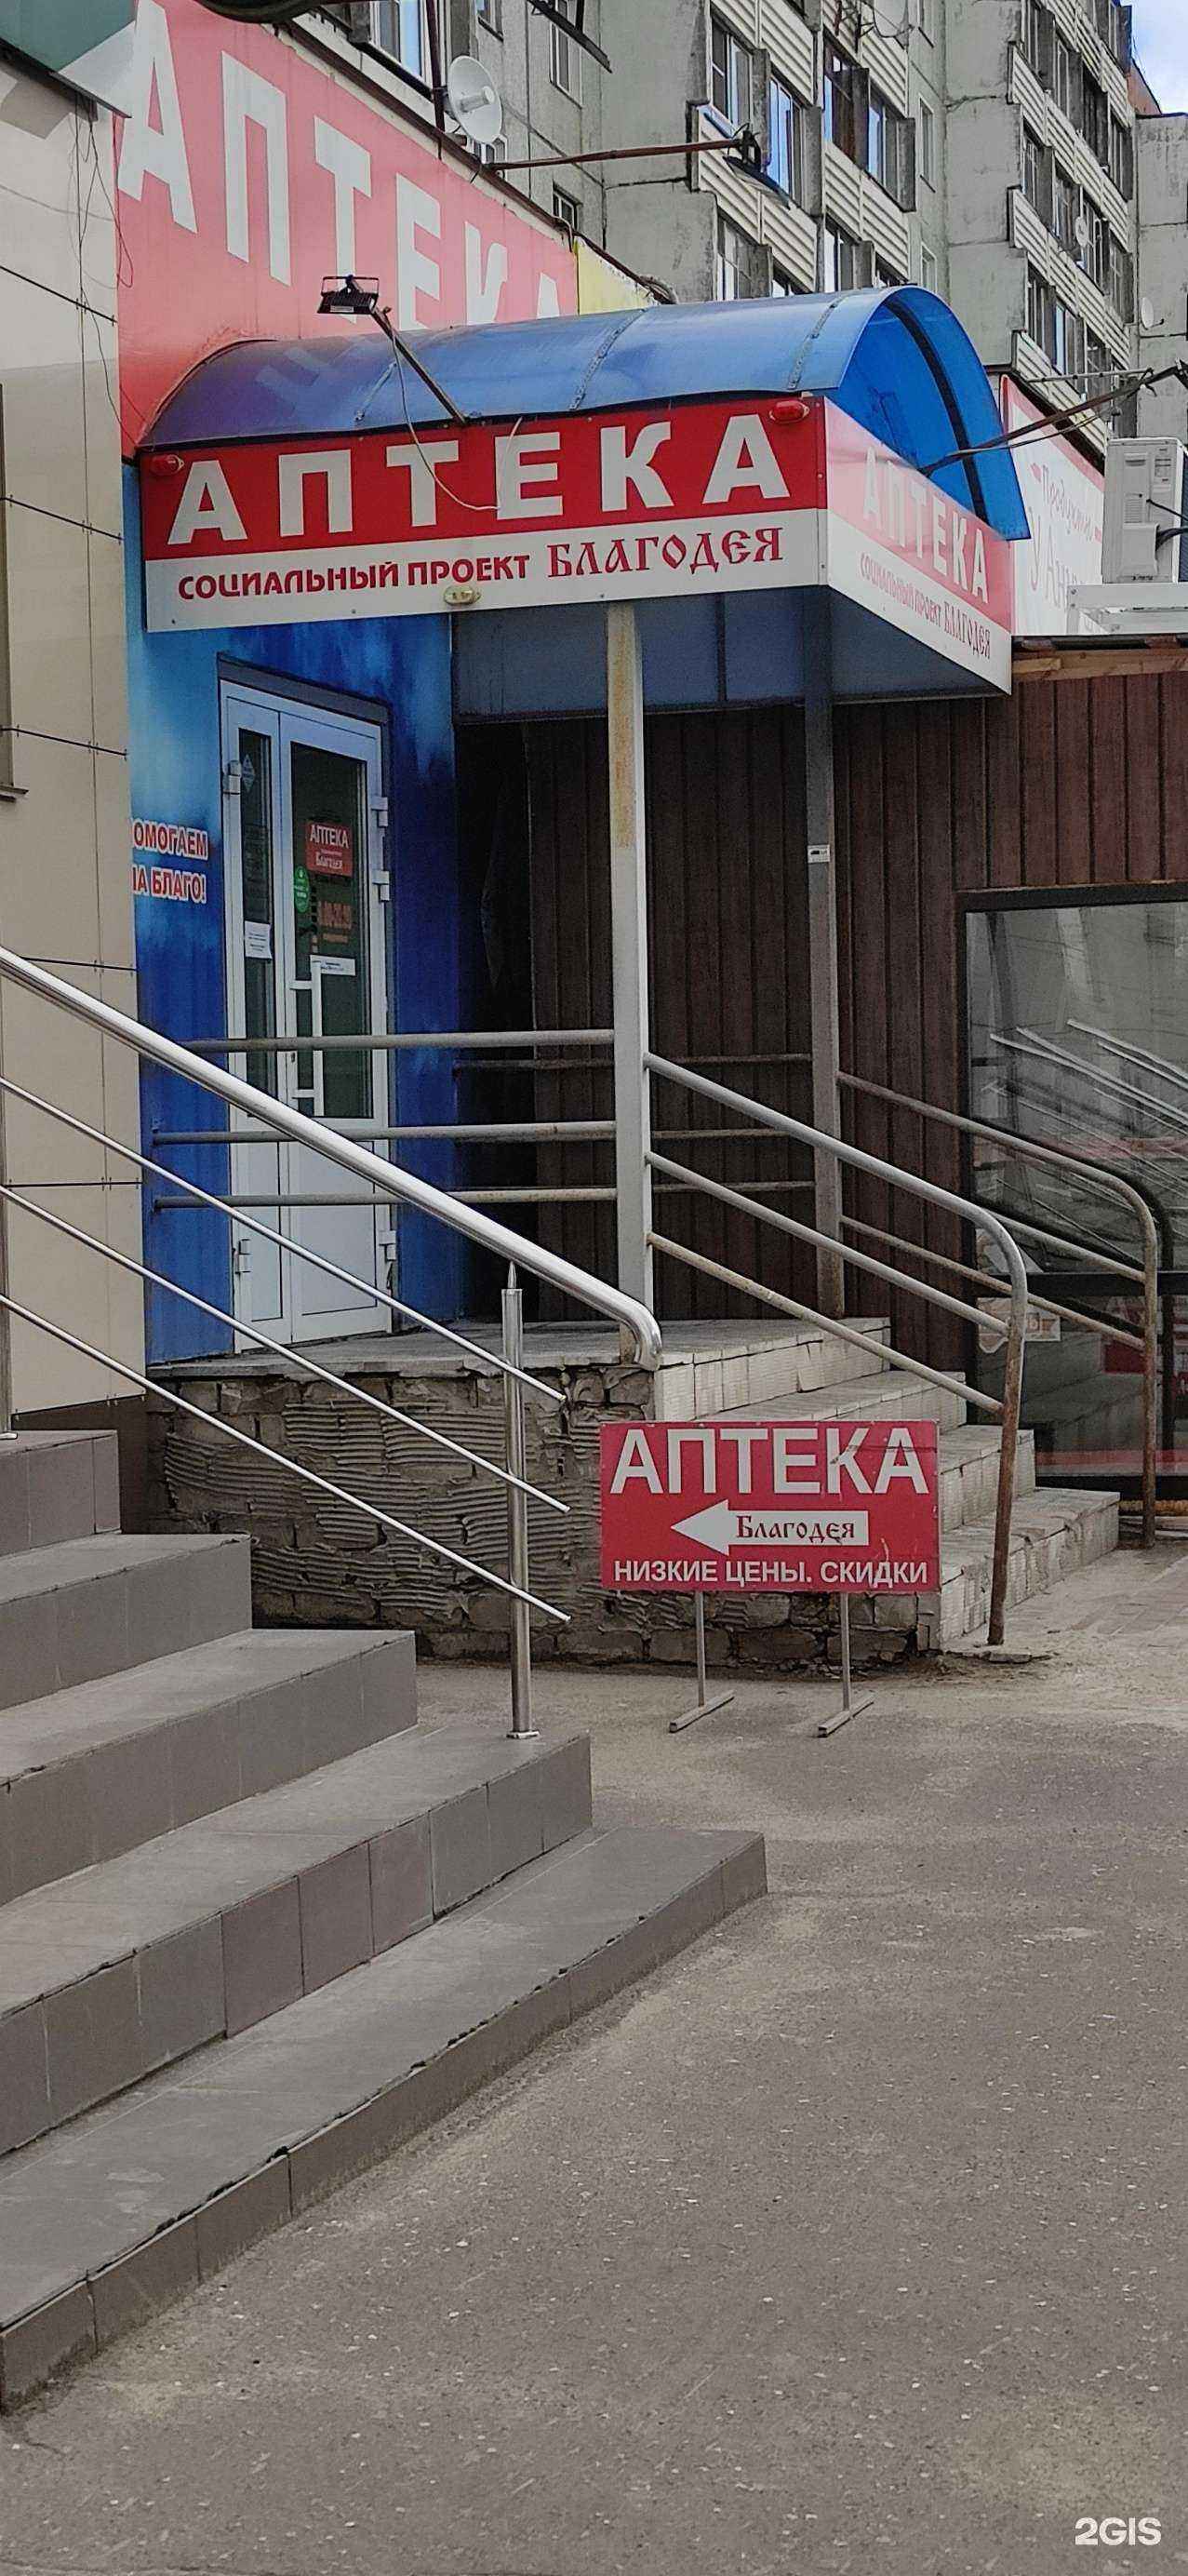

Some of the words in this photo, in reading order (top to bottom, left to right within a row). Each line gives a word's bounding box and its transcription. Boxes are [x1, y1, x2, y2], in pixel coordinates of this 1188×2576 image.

[167, 414, 791, 545] АПТЕКА
[863, 446, 989, 604] АПТЕКА
[178, 561, 399, 600] СОЦИАЛЬНЫЙ
[407, 555, 530, 587] ПРОЕКТ
[131, 818, 208, 861] ОМОГАЕМ
[310, 825, 349, 849] АПТЕКА
[151, 866, 207, 904] БЛАГО!
[610, 1427, 929, 1495] АПТЕКА
[736, 1515, 855, 1543] Благодея
[614, 1560, 718, 1583] НИЗКИЕ
[725, 1561, 812, 1587] ЦЕНЫ.
[820, 1561, 928, 1588] СКИДКИ
